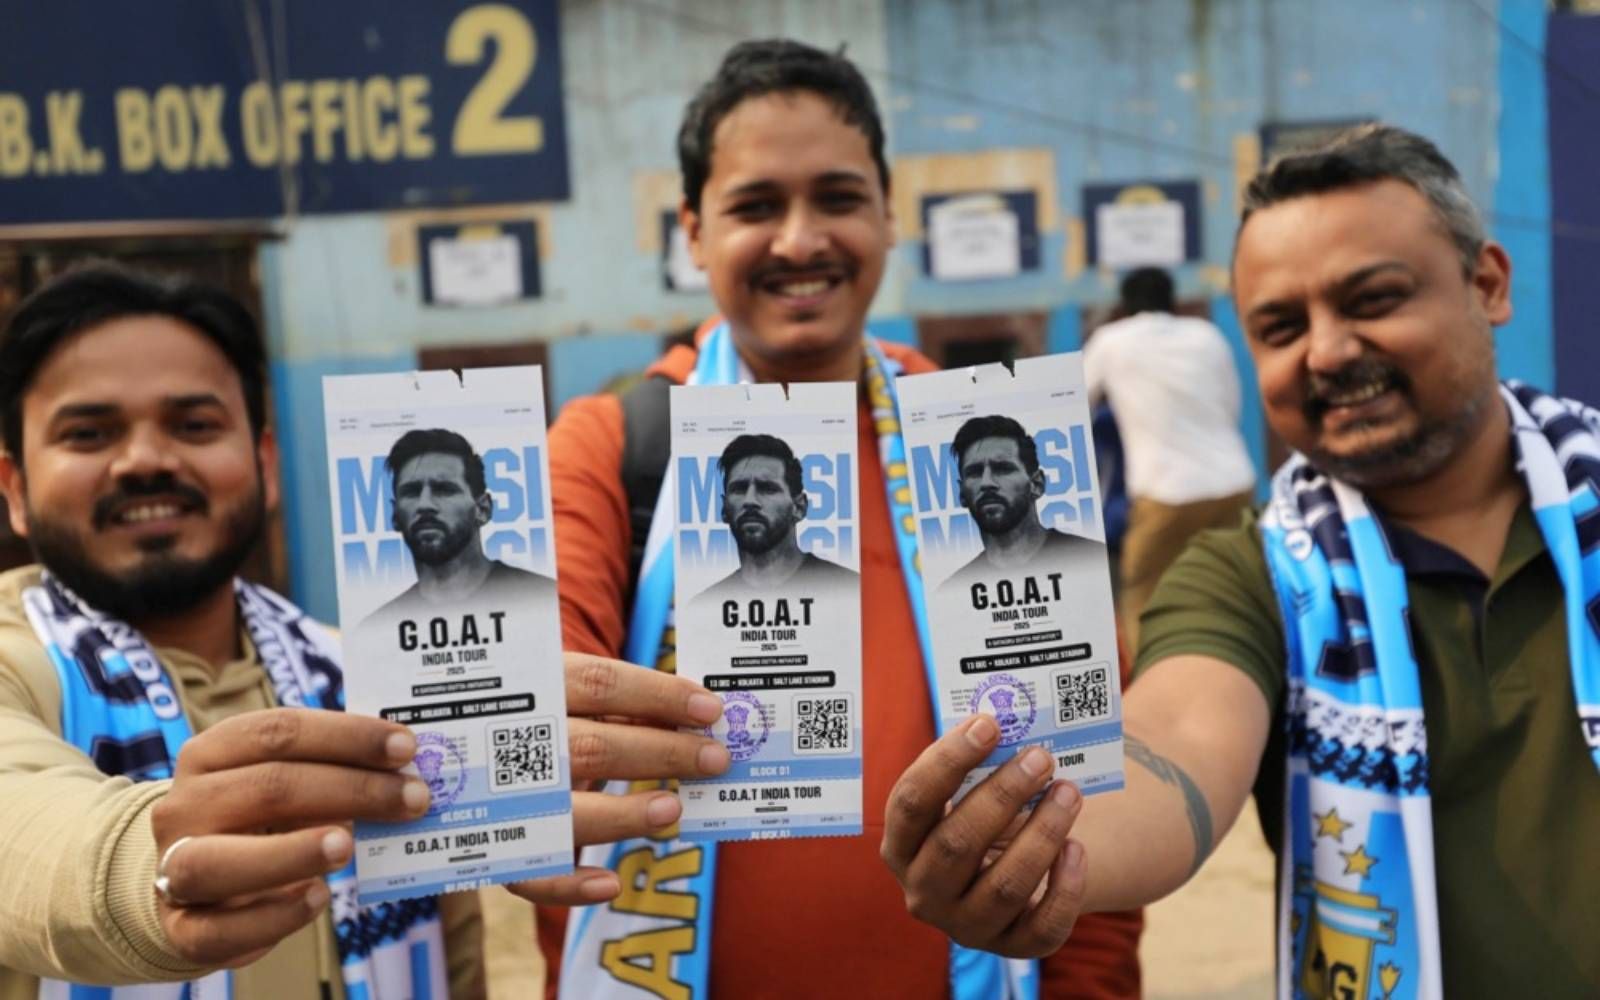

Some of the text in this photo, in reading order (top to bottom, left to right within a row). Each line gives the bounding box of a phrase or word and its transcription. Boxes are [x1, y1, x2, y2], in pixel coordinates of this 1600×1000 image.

[0, 3, 544, 178] B.K. BOX OFFICE 2
[971, 573, 1062, 610] G.O.A.T
[722, 598, 814, 628] G.O.A.T
[992, 606, 1048, 623] INDIA TOUR
[399, 611, 506, 652] G.O.A.T
[1013, 621, 1030, 630] 2025
[741, 629, 797, 642] INDIA TOUR
[761, 643, 778, 651] 2025
[422, 648, 488, 666] INDIA TOUR
[994, 656, 1021, 667] KOLKATA
[1029, 653, 1045, 663] SALT
[1045, 651, 1060, 662] LAKE
[1060, 648, 1086, 659] STADIUM
[446, 666, 465, 676] 2025
[738, 678, 764, 686] KOLKATA
[773, 677, 788, 685] SALT
[789, 676, 803, 685] LAKE
[804, 676, 830, 684] STADIUM
[420, 707, 452, 719] KOLKATA
[462, 704, 480, 714] SALT
[481, 702, 498, 713] LAKE
[1058, 753, 1085, 768] TOUR
[750, 765, 790, 776] BLOCK 01
[719, 788, 757, 802] G.O.A.T
[761, 787, 790, 800] INDIA
[794, 786, 822, 799] TOUR
[441, 807, 488, 823] BLOCK 01
[404, 837, 450, 855] G.O.A.T
[455, 831, 490, 848] INDIA
[494, 827, 526, 842] TOUR
